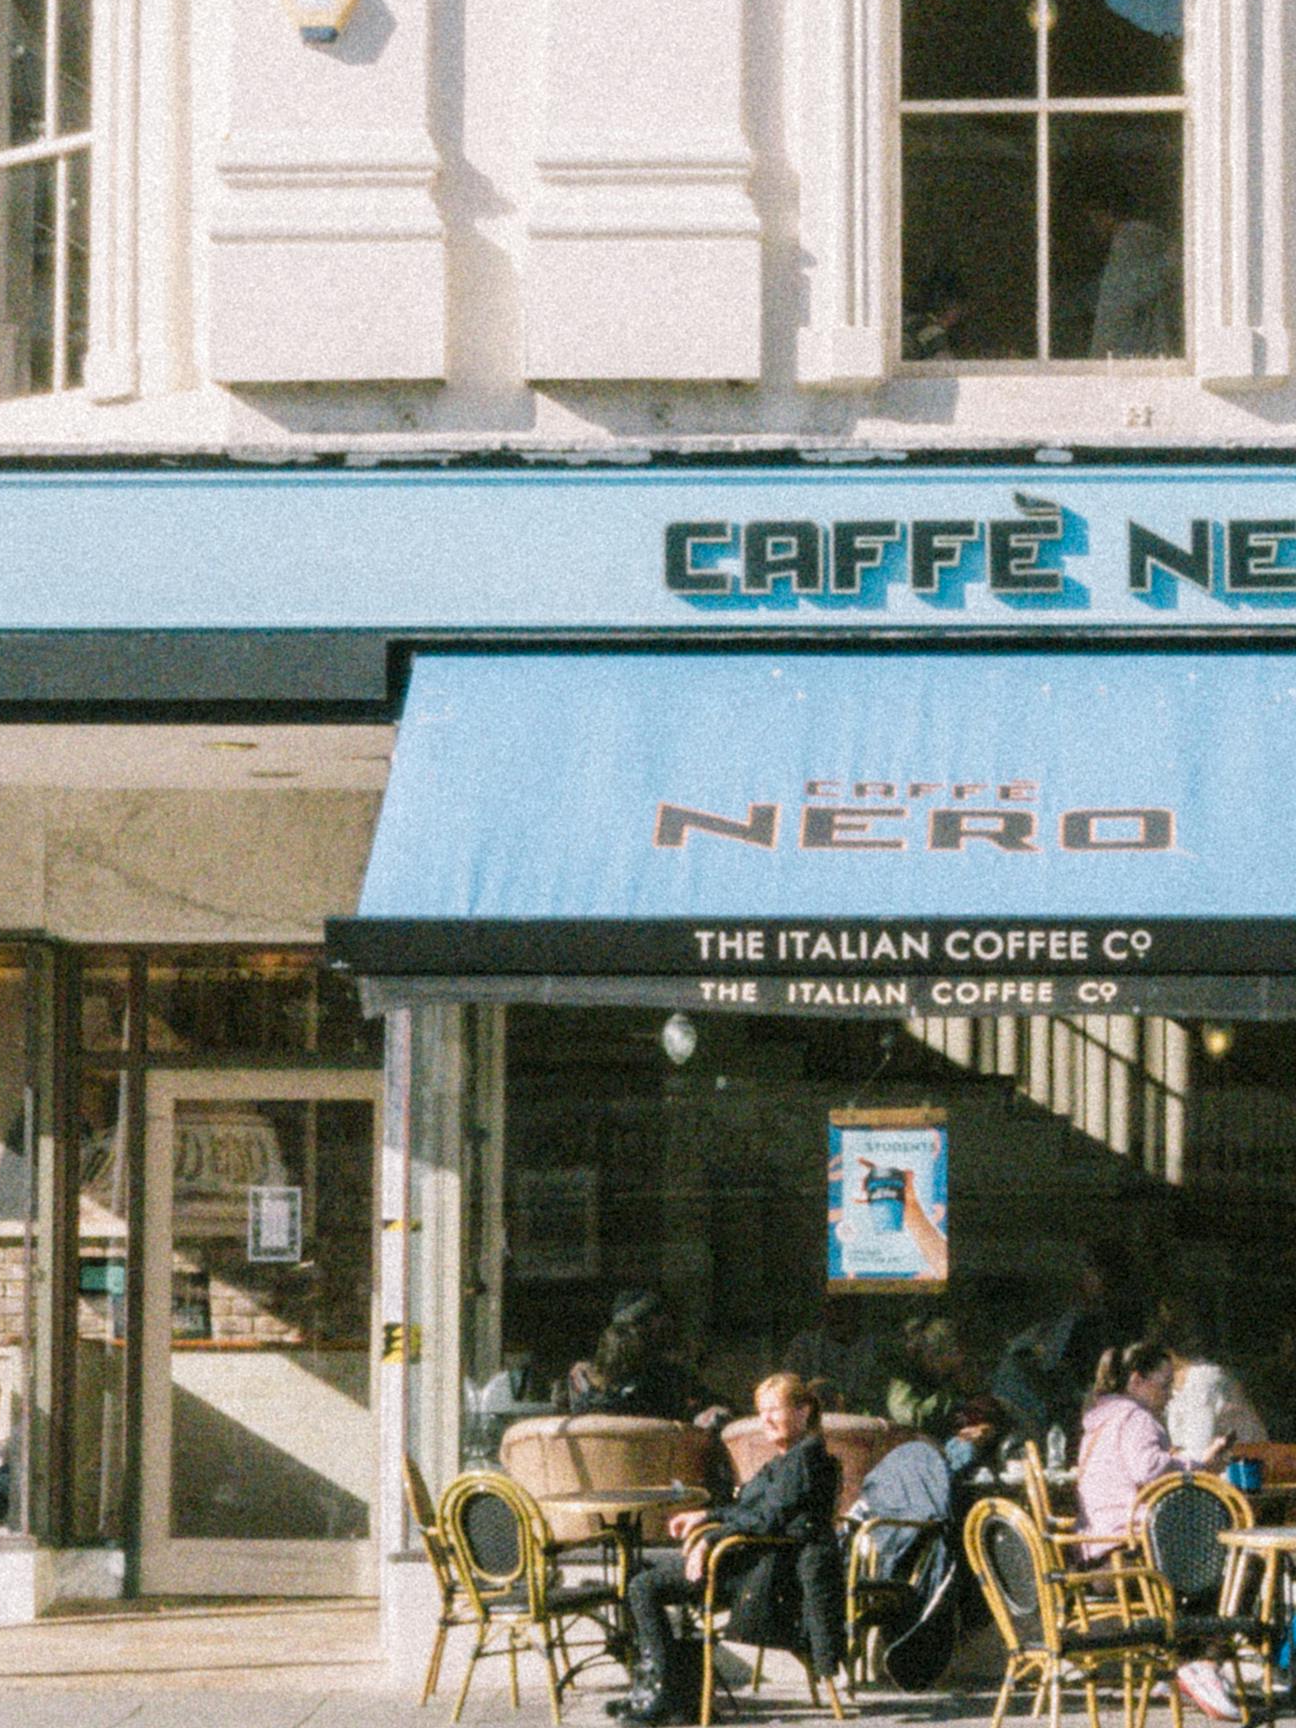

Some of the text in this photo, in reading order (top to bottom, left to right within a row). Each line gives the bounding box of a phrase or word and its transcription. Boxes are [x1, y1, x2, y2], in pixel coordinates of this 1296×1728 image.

[664, 491, 1064, 597] CAFFÈ
[652, 802, 1178, 852] NERO
[694, 930, 764, 961] THE
[778, 930, 930, 961] ITALIAN
[945, 930, 1088, 961] COFFEE
[700, 981, 758, 1004] THE
[788, 981, 906, 1005] ITALIAN
[931, 981, 1053, 1005] COFFEE
